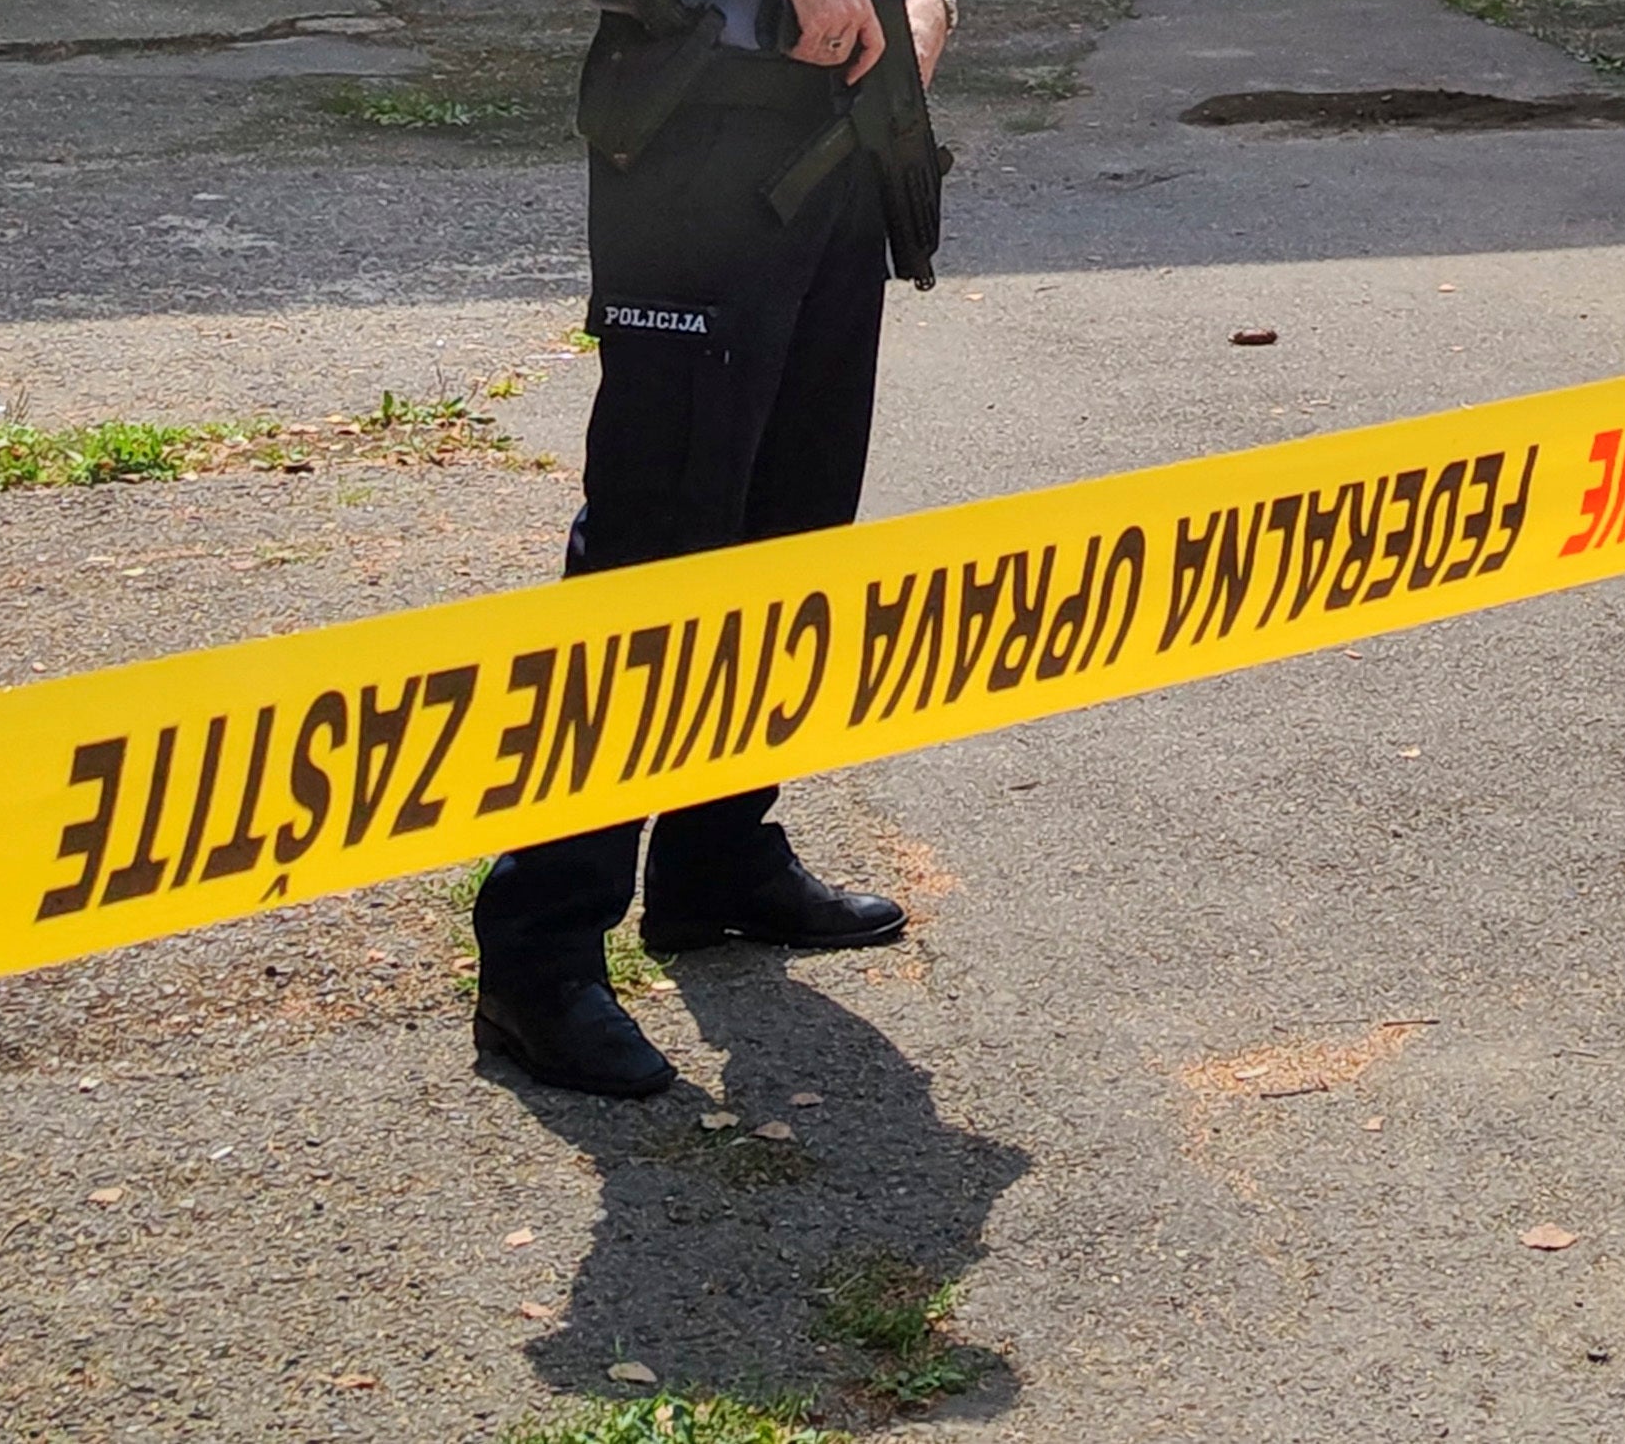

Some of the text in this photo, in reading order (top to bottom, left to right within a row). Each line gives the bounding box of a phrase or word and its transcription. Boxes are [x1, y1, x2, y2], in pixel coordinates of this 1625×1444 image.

[604, 306, 708, 333] POLICIJA
[35, 445, 1539, 923] FEDERALNA UPRAVA CIVILNE ZAŠTITE
